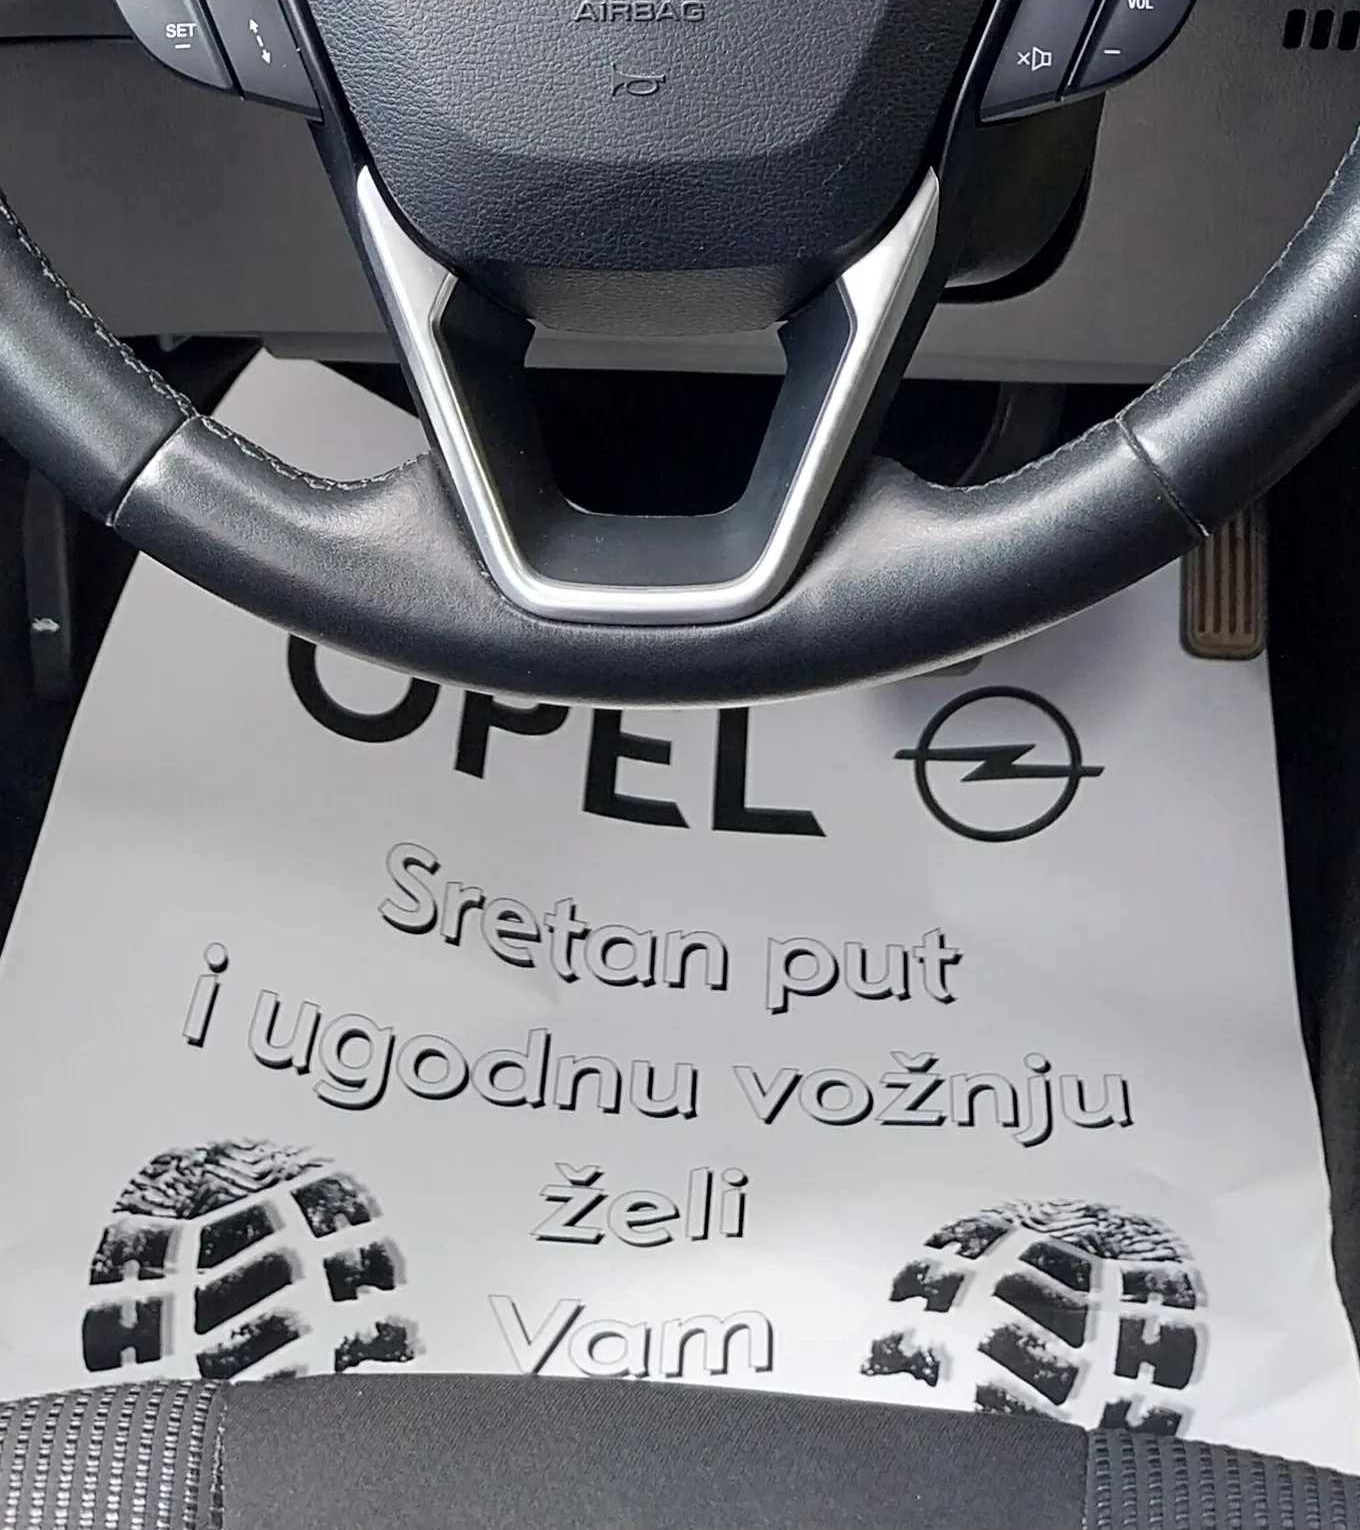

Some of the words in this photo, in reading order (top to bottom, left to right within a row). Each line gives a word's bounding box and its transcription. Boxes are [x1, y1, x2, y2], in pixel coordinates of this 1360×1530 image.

[166, 23, 196, 38] SET
[574, 0, 706, 23] AIRBAG
[287, 633, 827, 837] OPEL
[378, 841, 728, 994] Sretan
[766, 926, 963, 1014] put
[182, 942, 229, 1048] i
[249, 988, 698, 1122] ugodnu
[736, 1050, 1135, 1148] vožnju
[530, 1162, 750, 1248] želi
[488, 1293, 775, 1380] Vam
